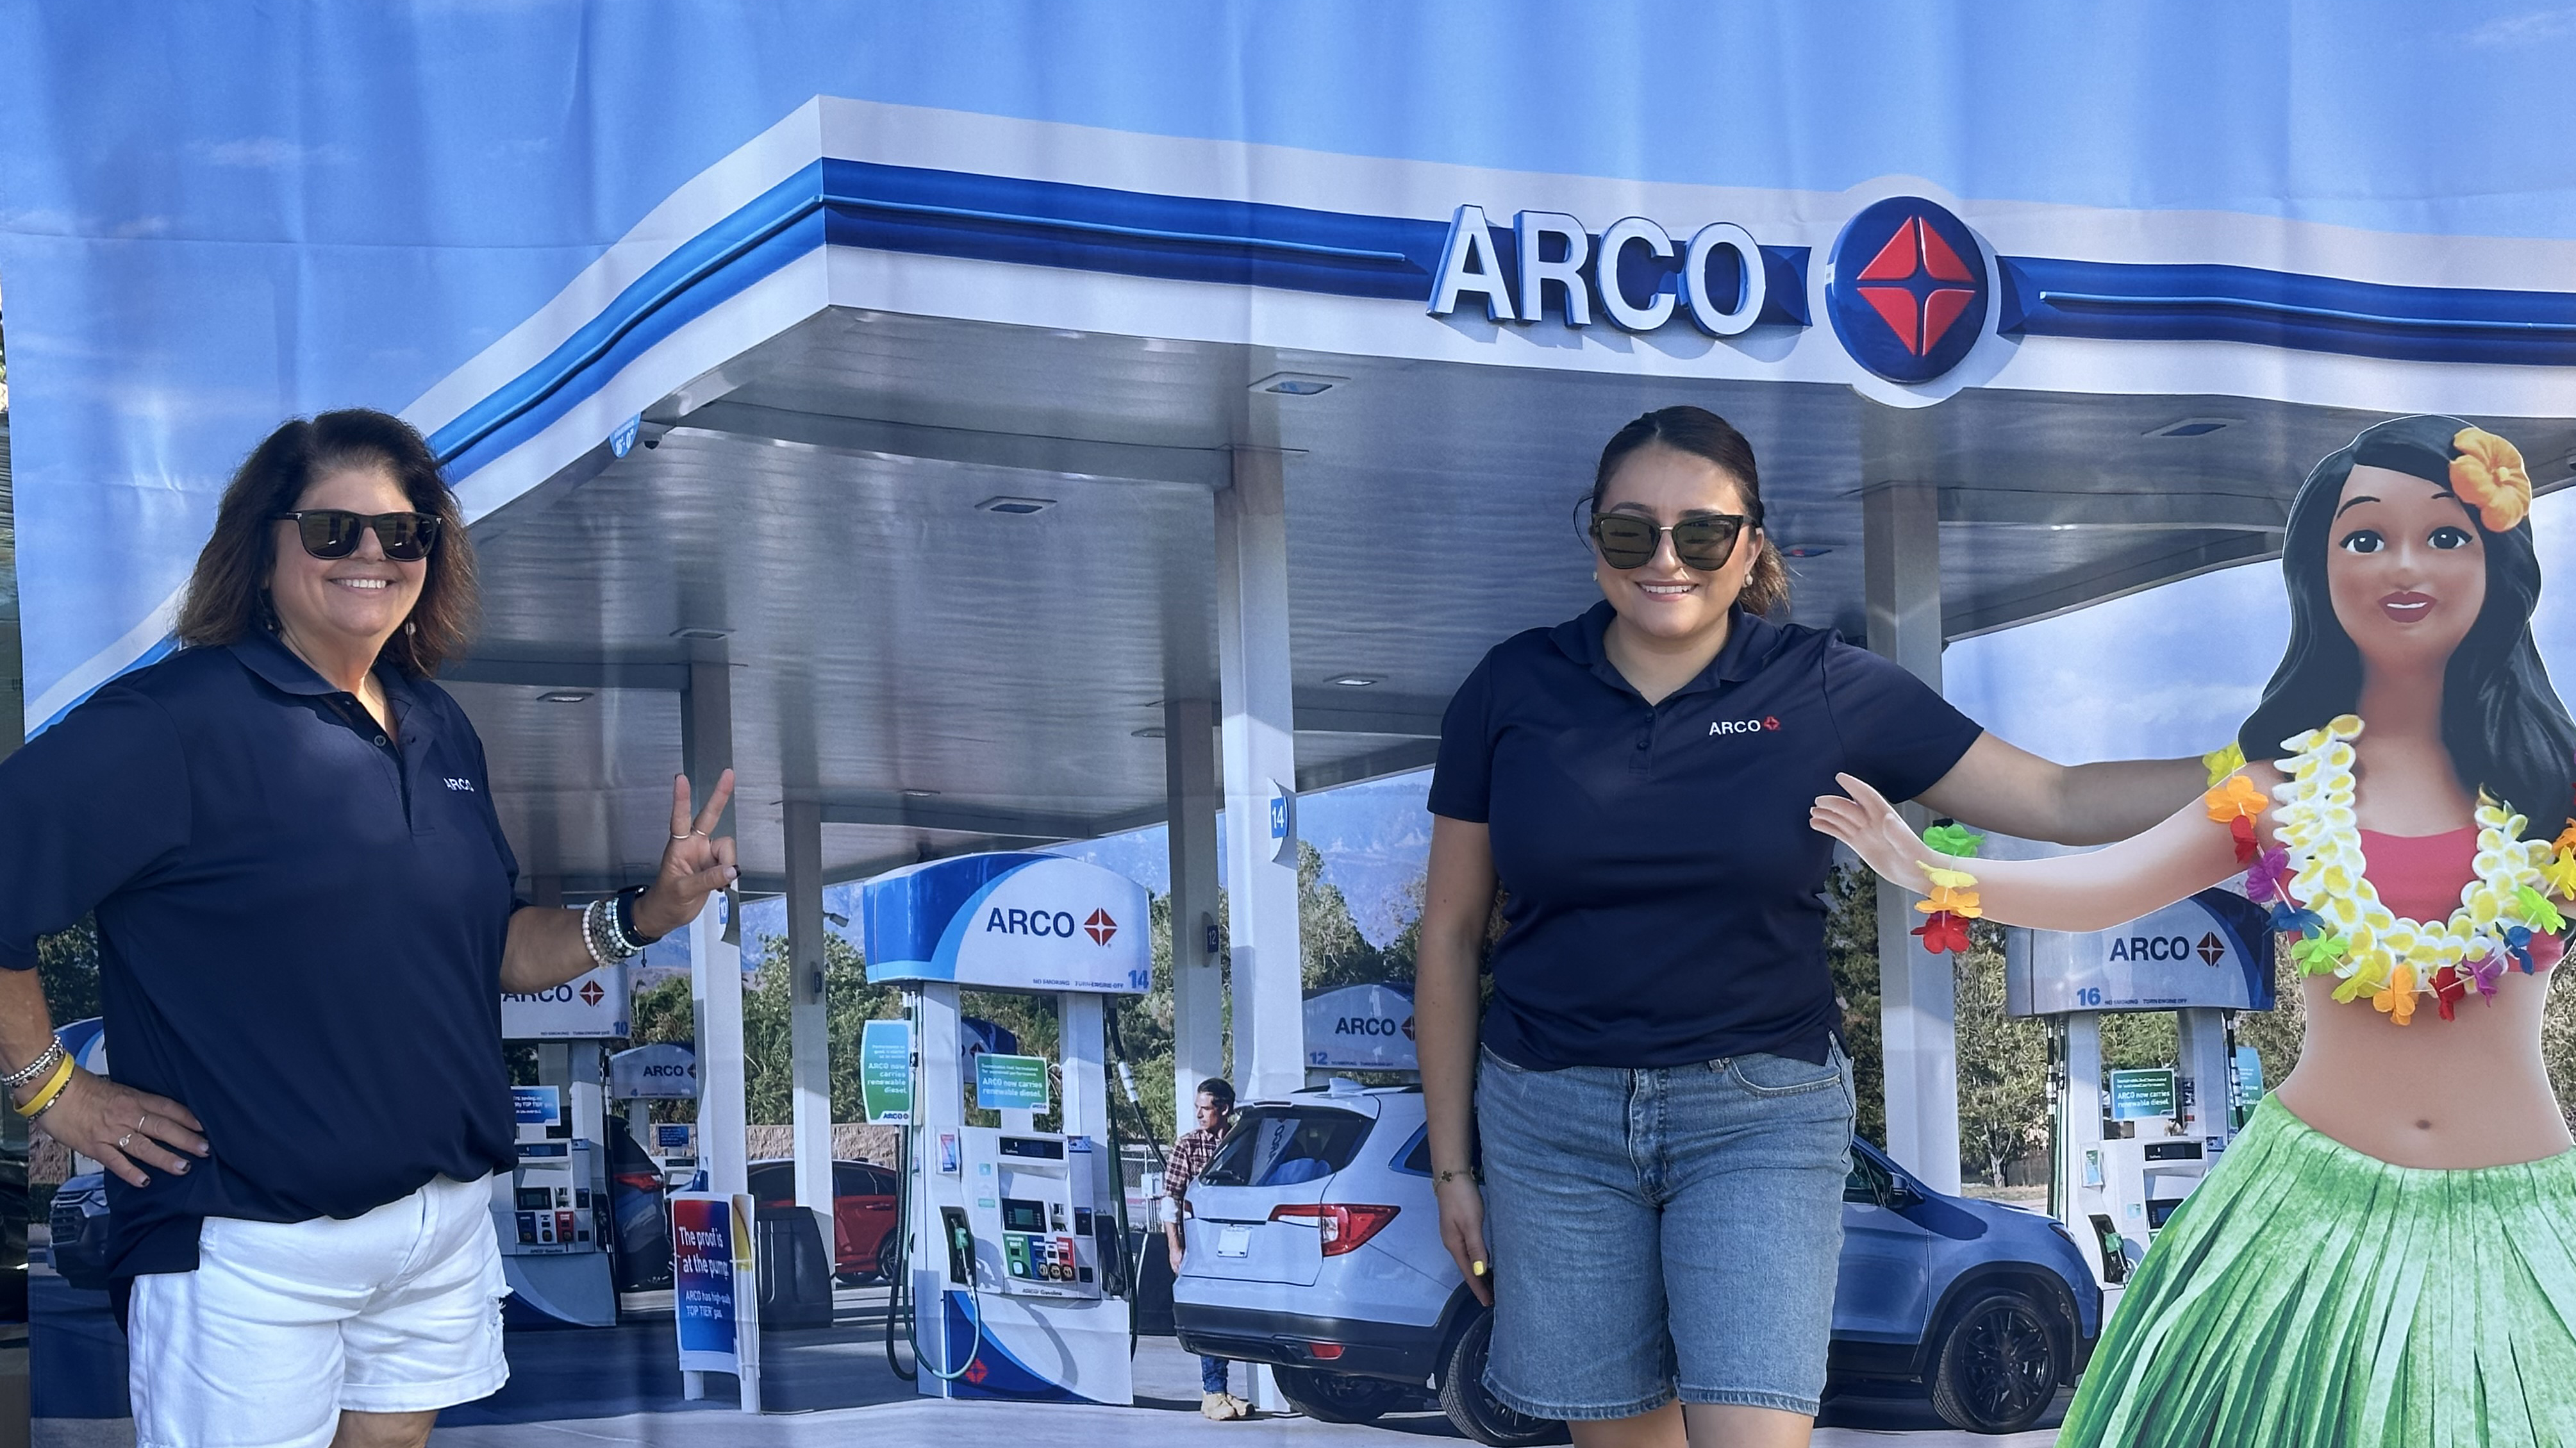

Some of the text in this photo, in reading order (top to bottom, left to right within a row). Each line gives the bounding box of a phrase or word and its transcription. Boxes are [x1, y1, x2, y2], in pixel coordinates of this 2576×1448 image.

[1426, 204, 1766, 337] ARCO
[1709, 720, 1761, 735] ARCO
[444, 778, 474, 792] ARCO
[1272, 805, 1284, 829] 14
[986, 907, 1075, 938] ARCO
[1208, 930, 1217, 945] 12
[2109, 936, 2190, 961] ARCO
[1129, 970, 1149, 989] 14
[2077, 987, 2101, 1006] 16
[613, 1021, 629, 1036] 10
[1334, 1017, 1396, 1036] ARCO
[1309, 1052, 1328, 1065] 12
[643, 1065, 684, 1077] ARCO
[983, 1078, 1002, 1086] ARCO
[631, 1088, 638, 1097] 4
[2118, 1091, 2135, 1099] ARCO
[679, 1226, 724, 1251] The proof is
[683, 1254, 693, 1273] at
[694, 1252, 709, 1273] the
[686, 1290, 701, 1301] ARCO
[701, 1290, 711, 1302] has
[686, 1305, 699, 1317] TOP
